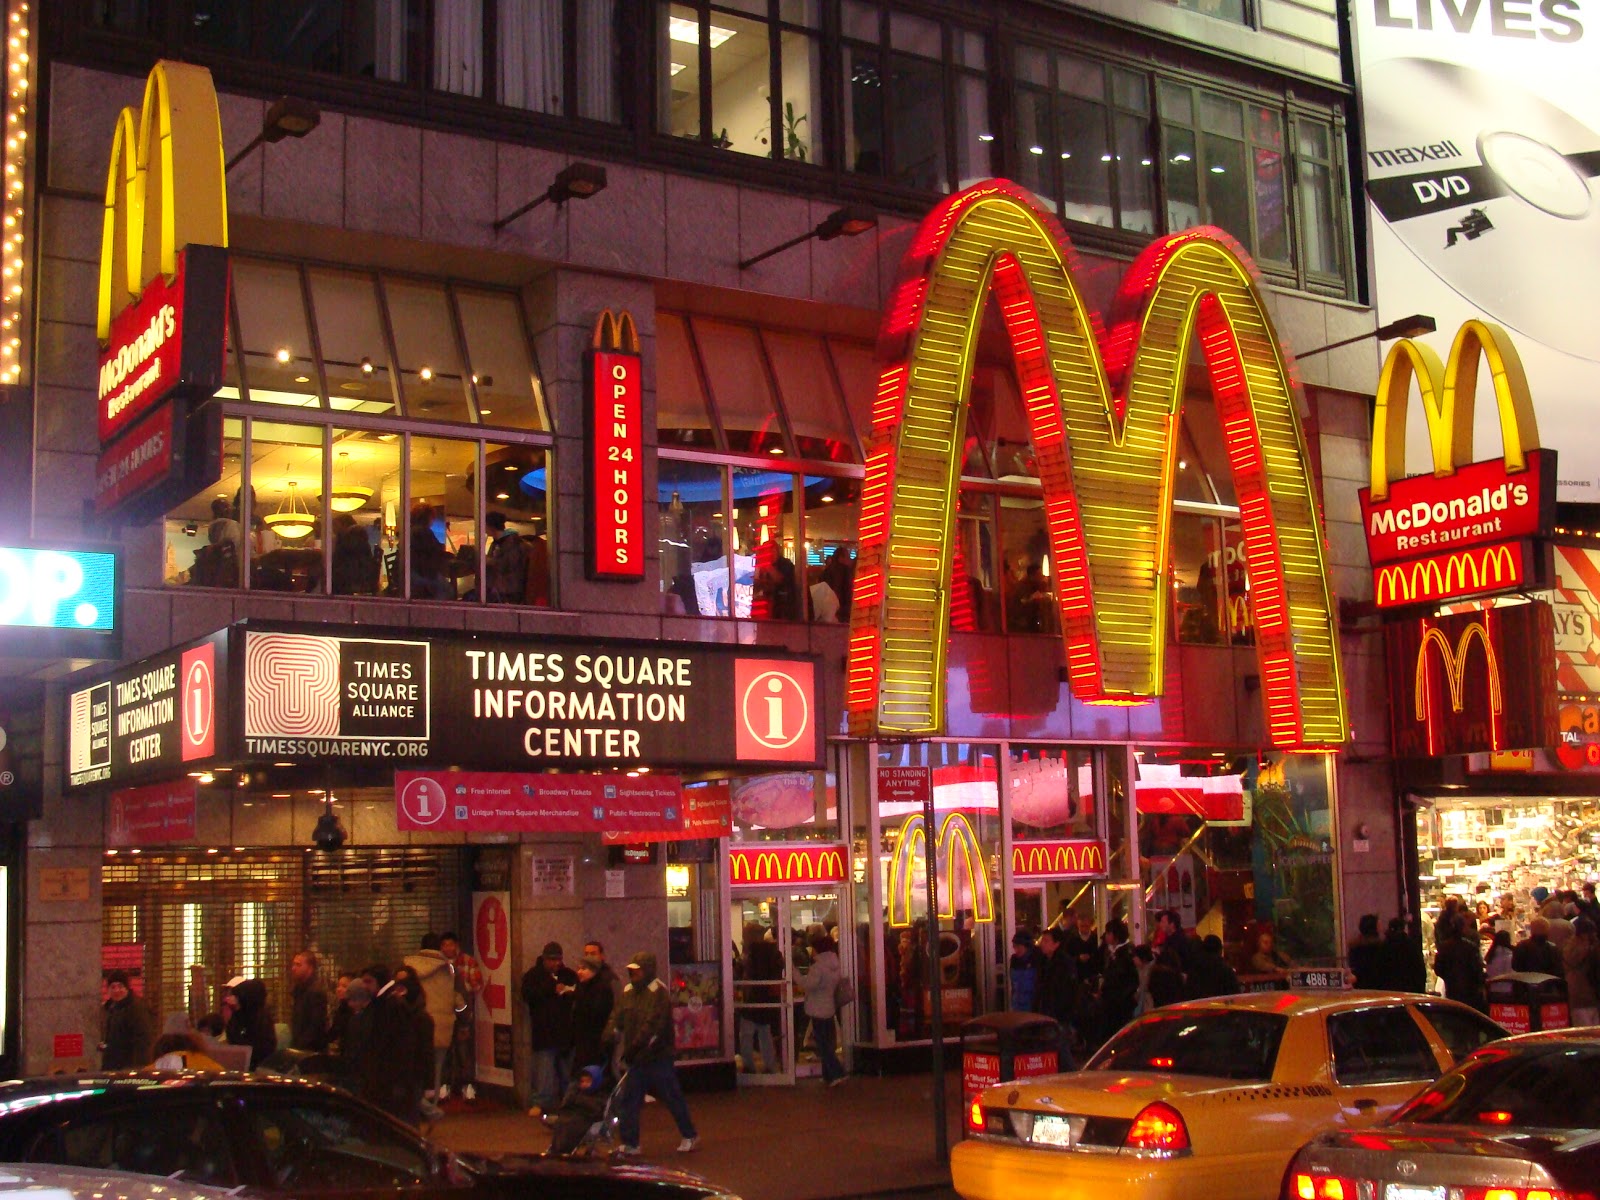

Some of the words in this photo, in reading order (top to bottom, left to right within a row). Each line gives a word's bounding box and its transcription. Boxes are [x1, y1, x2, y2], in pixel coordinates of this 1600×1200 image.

[1374, 0, 1584, 44] LIVES
[1367, 140, 1463, 168] maxell
[1412, 175, 1471, 204] DVD
[99, 304, 175, 400] McDonald's
[108, 357, 161, 419] Restaurant
[612, 365, 627, 439] OPEN
[608, 446, 633, 462] 24
[613, 469, 628, 564] HOURS
[1371, 482, 1529, 536] McDonald's
[1396, 516, 1502, 550] Restaurant
[354, 661, 412, 680] TIMES
[465, 650, 565, 683] TIMES
[575, 654, 692, 689] SQUARE
[116, 676, 141, 707] TIMES
[142, 663, 176, 701] SQUARE
[347, 682, 418, 702] SQUARE
[117, 696, 174, 737] INFORMATION
[352, 704, 415, 719] ALLIANCE
[474, 688, 686, 722] INFORMATION
[130, 733, 161, 764] CENTER
[245, 738, 429, 758] TIMESSQUARENYC.ORG
[524, 727, 641, 758] CENTER
[880, 769, 890, 777] NO
[892, 769, 926, 778] STANDING
[539, 788, 569, 797] Broadway
[570, 788, 592, 796] Tickets
[619, 789, 654, 798] Sightseeing
[471, 809, 494, 817] Unique
[516, 809, 538, 817] Square
[539, 809, 580, 817] Merchandise
[629, 809, 661, 817] Restrooms
[1305, 973, 1328, 986] 4B86
